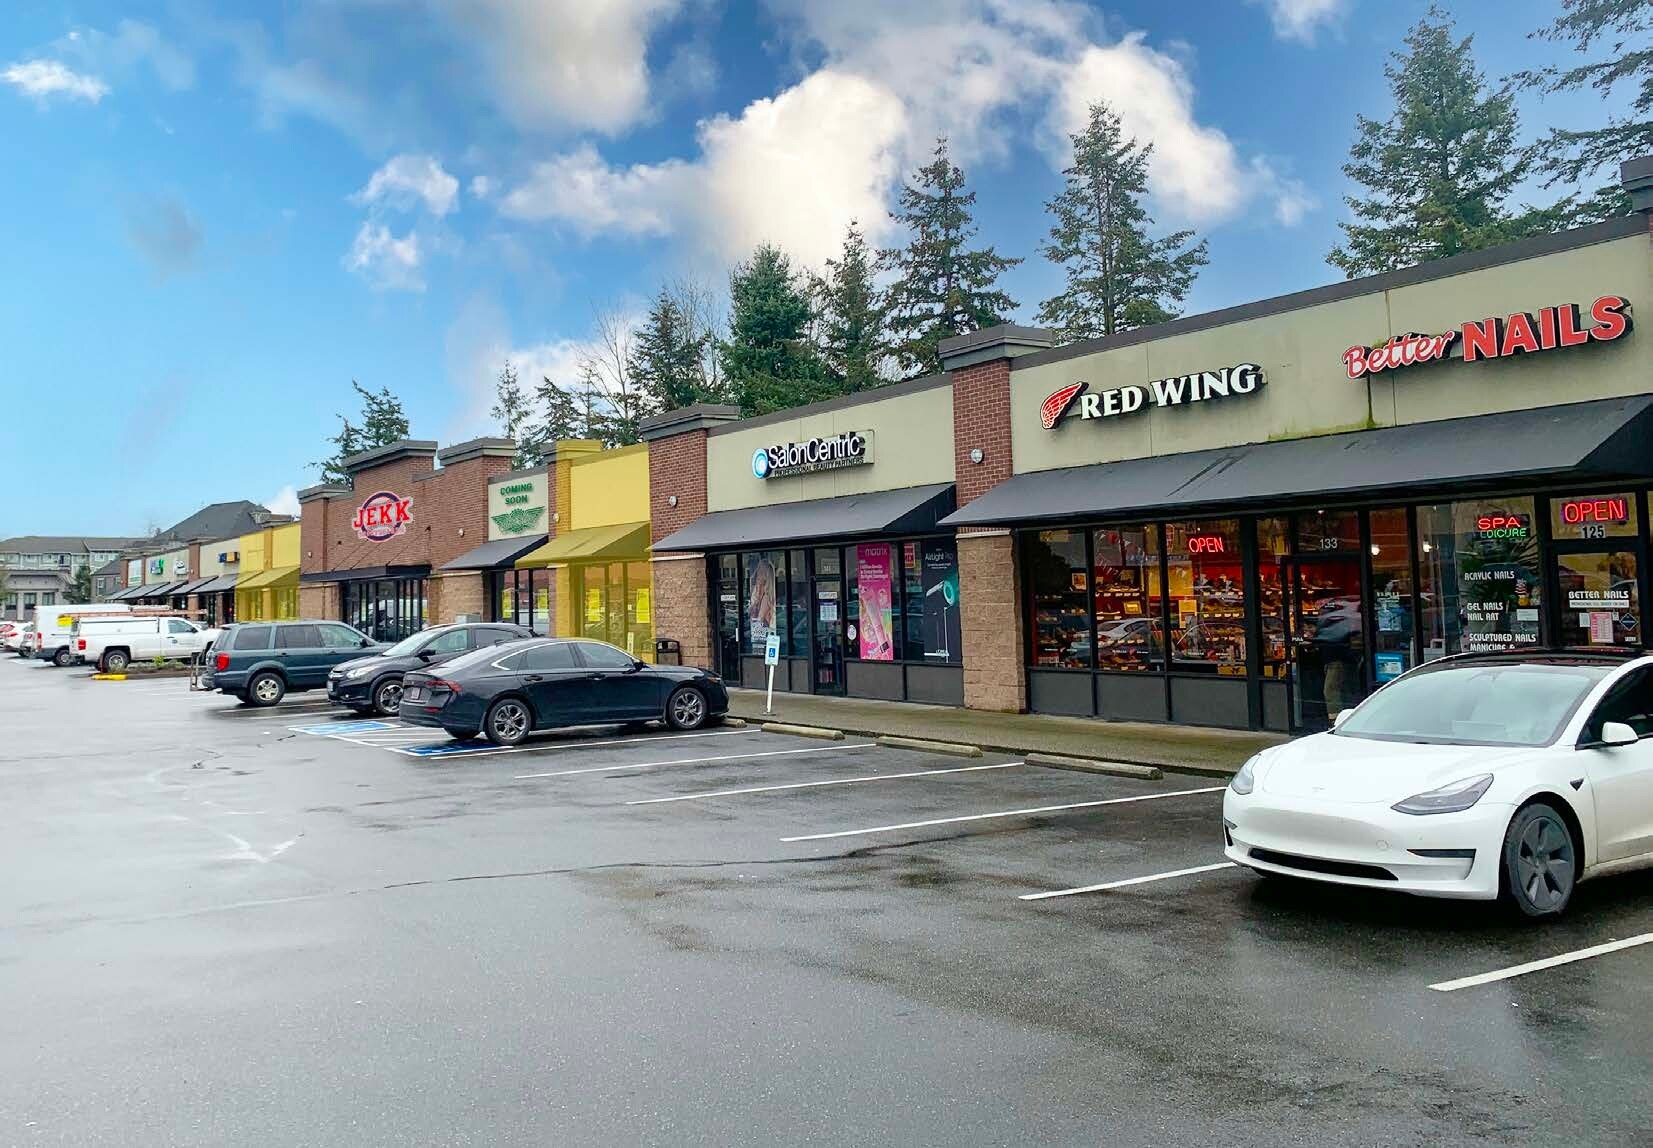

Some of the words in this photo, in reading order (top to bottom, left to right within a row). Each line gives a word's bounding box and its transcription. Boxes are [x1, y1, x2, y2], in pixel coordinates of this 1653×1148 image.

[1343, 329, 1454, 379] Better
[1462, 297, 1629, 362] NAILS
[1080, 384, 1143, 420] RED
[1150, 364, 1257, 407] WING
[768, 432, 861, 469] SalonCentric
[500, 483, 533, 496] COMING
[505, 495, 528, 505] SOON
[353, 499, 410, 528] JEKK
[1564, 499, 1624, 522] OPEN
[1478, 516, 1521, 530] SPA
[1582, 525, 1604, 538] 125
[1188, 537, 1224, 553] OPEN
[1319, 537, 1338, 549] 133
[865, 547, 888, 556] matrix
[1464, 571, 1492, 580] ACRYLIC
[1494, 570, 1515, 580] NAILS
[1568, 590, 1600, 599] BETTER
[1603, 590, 1629, 599] NAILS
[1466, 602, 1481, 611] GEL
[1483, 602, 1504, 611] NAILS
[1467, 613, 1484, 621] NAIL
[1485, 612, 1499, 621] ART
[1469, 633, 1512, 642] SCULPTURED
[1515, 633, 1537, 642] NAILS
[1469, 643, 1506, 652] MANICURE
